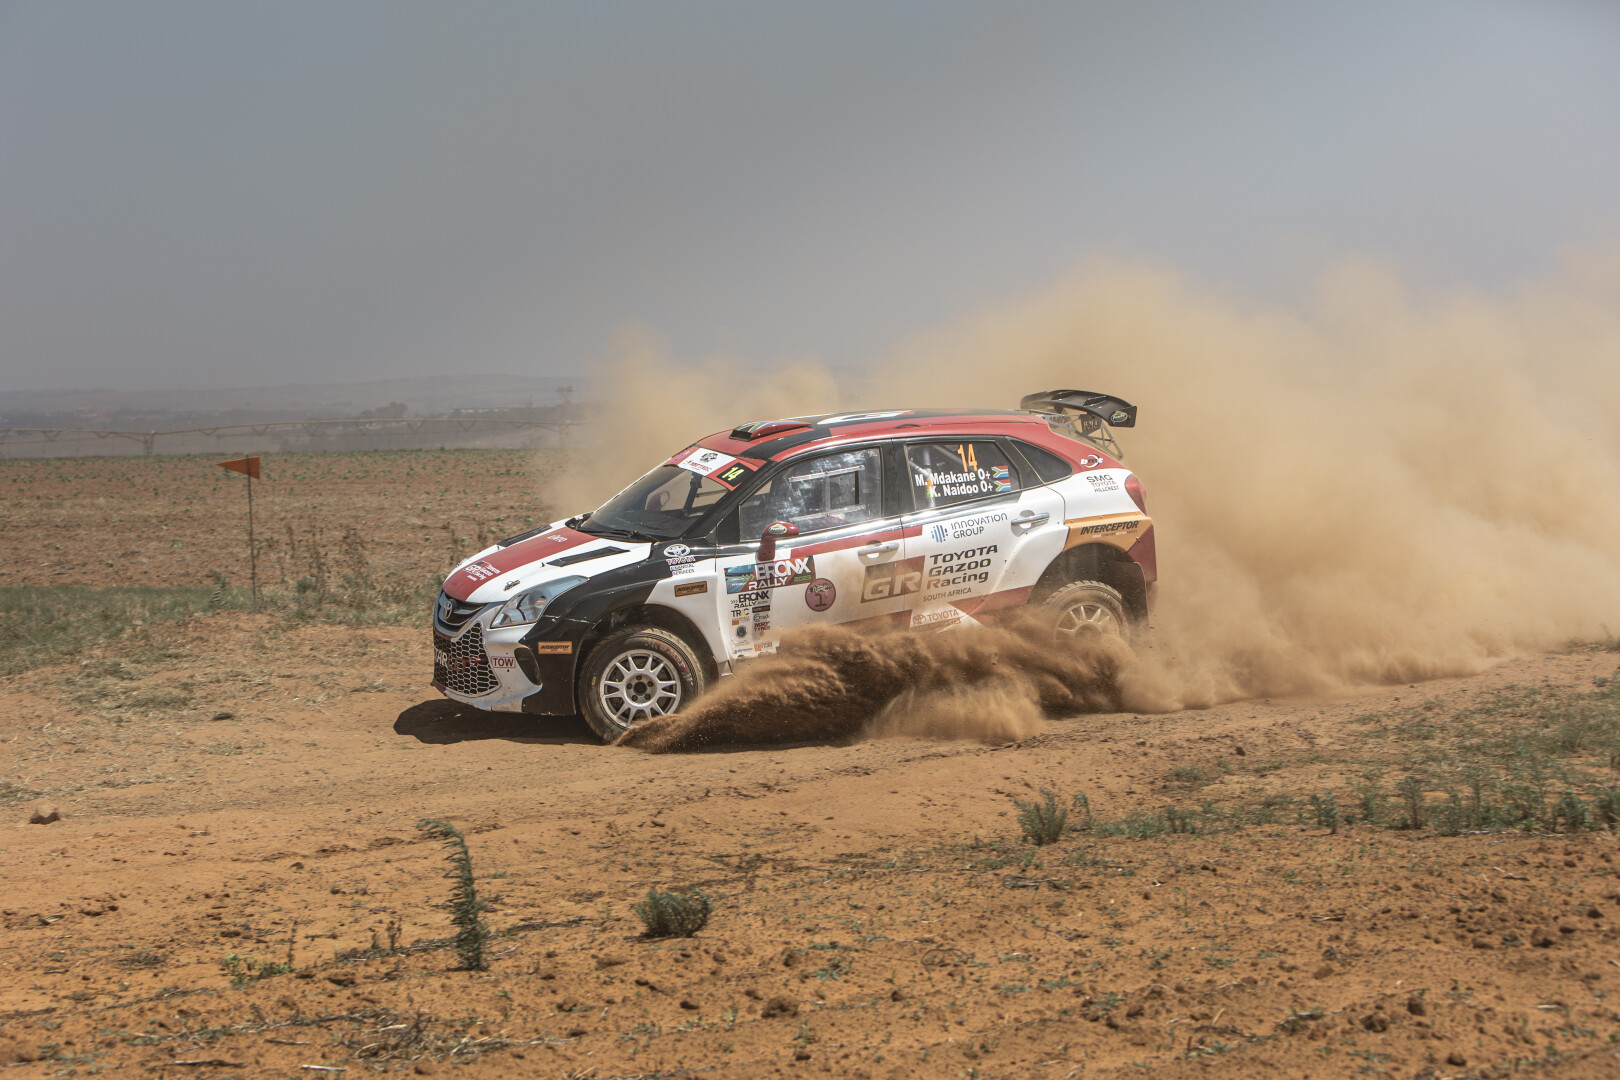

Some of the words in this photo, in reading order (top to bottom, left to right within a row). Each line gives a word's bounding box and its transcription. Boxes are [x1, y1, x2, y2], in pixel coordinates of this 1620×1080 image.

[957, 443, 978, 472] 14
[721, 466, 745, 481] 14
[914, 474, 928, 486] M.
[930, 471, 976, 485] Mdakane
[1086, 474, 1114, 483] SMG
[943, 482, 979, 496] Naidoo
[1091, 480, 1117, 488] TOYOTA
[950, 513, 1008, 530] INNOVATION
[1080, 520, 1139, 535] INTERCEPTOR
[953, 526, 985, 539] GROUP
[930, 544, 998, 565] TOYOTA
[756, 557, 811, 580] BRONX
[929, 558, 991, 577] GAZOO
[748, 577, 788, 590] RALLY
[863, 571, 922, 600] GR
[926, 571, 989, 590] Racing
[738, 590, 769, 603] BRONX
[815, 593, 827, 607] 1
[923, 592, 946, 602] SOUTH
[947, 587, 972, 597] AFRICA
[734, 601, 756, 609] RALLY
[927, 609, 960, 622] TOYOTA
[492, 657, 514, 667] TOW
